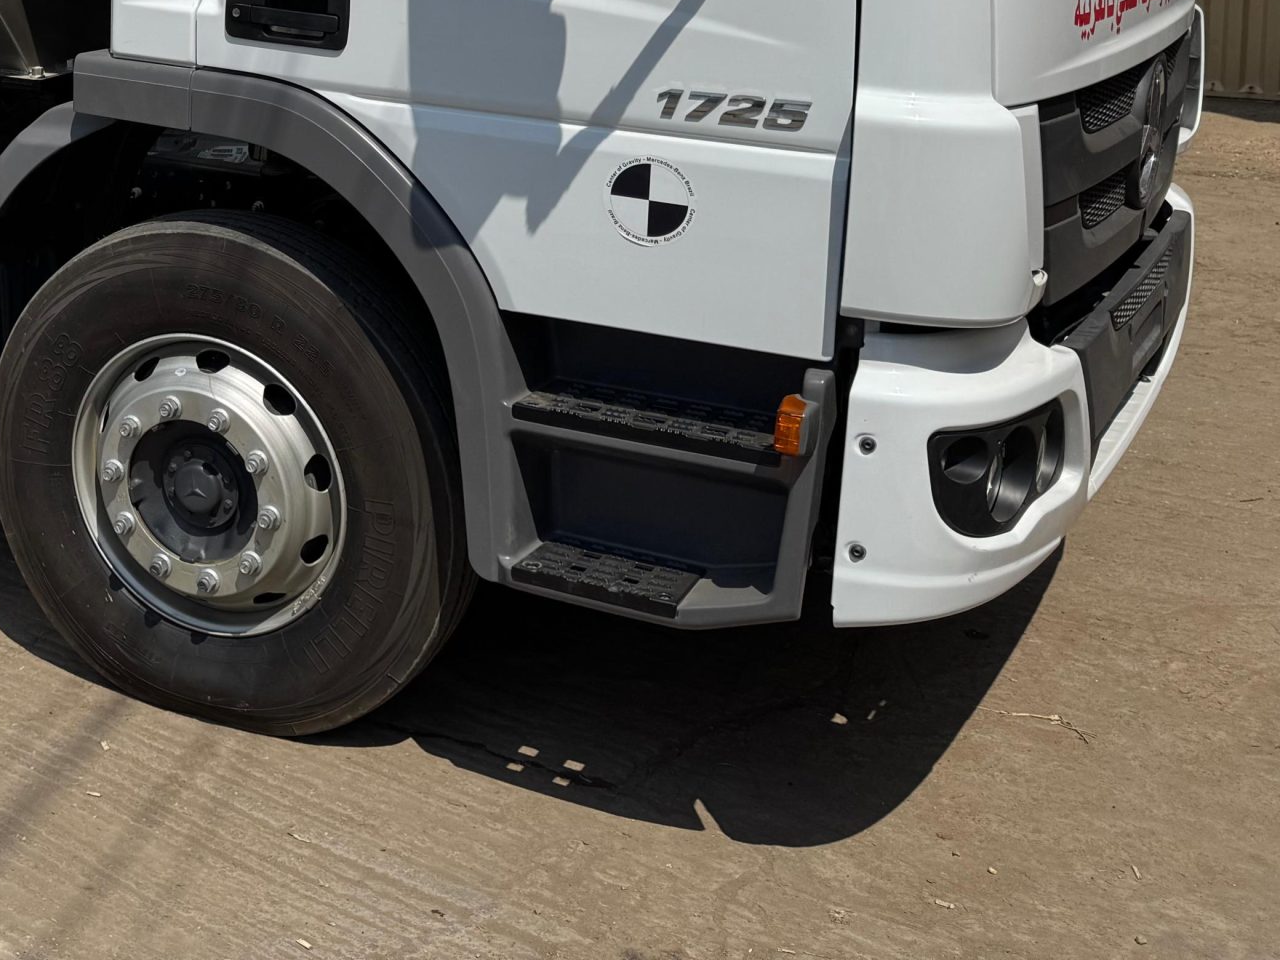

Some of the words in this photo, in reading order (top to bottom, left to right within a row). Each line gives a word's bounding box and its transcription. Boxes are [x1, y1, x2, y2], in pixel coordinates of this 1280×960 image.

[655, 89, 813, 132] 1725
[606, 170, 618, 188] Center
[622, 158, 642, 168] Gravity
[303, 497, 398, 676] PIRELLI
